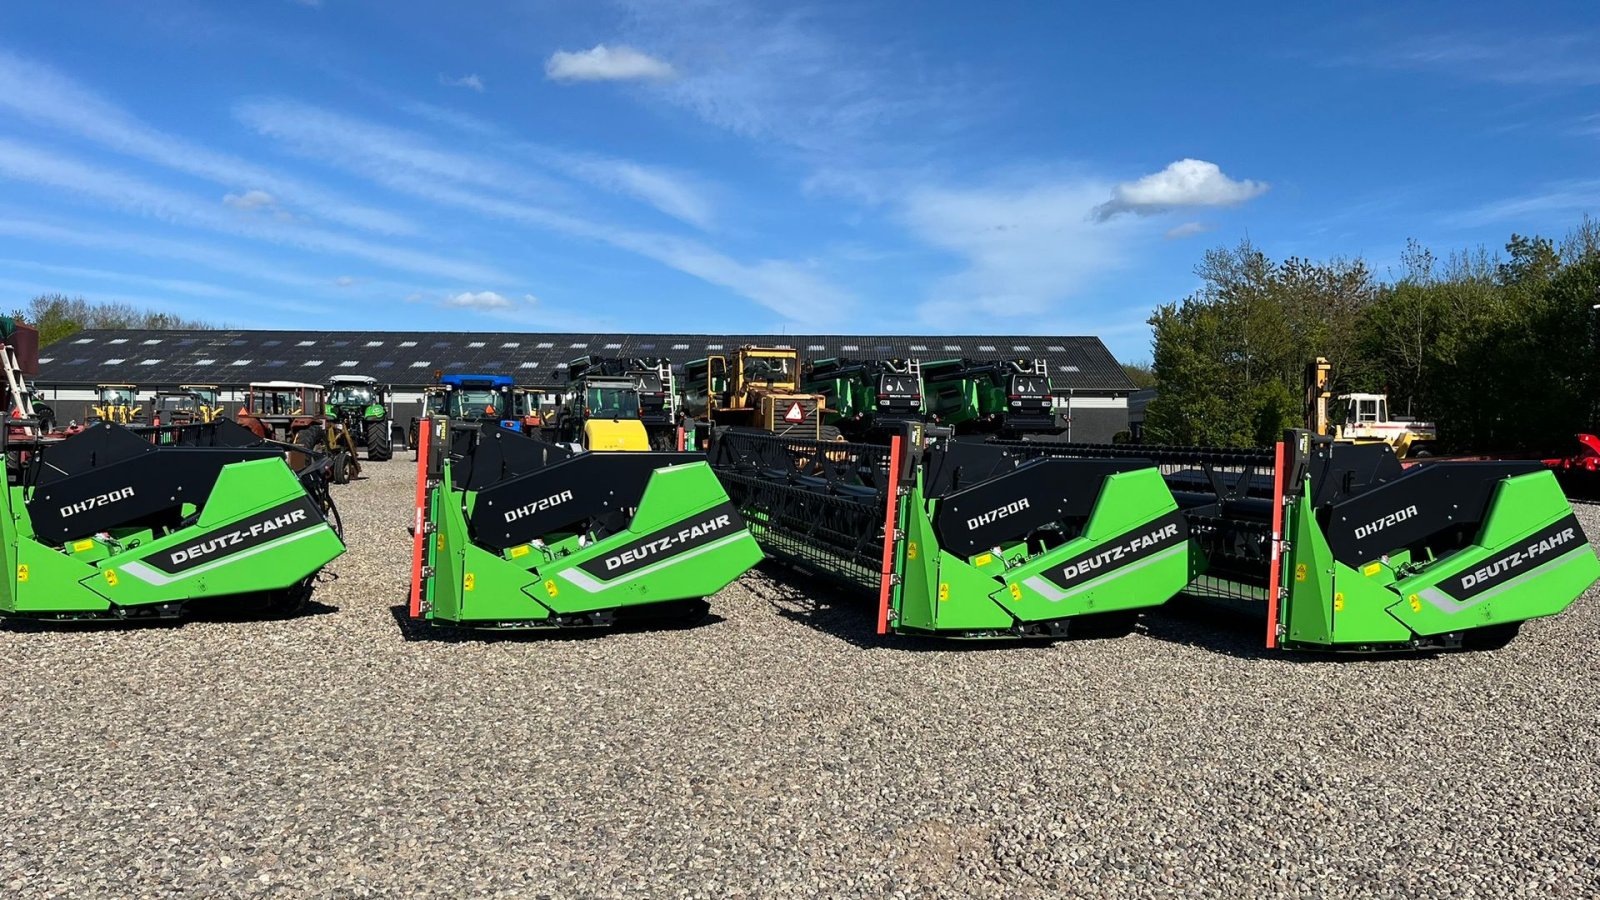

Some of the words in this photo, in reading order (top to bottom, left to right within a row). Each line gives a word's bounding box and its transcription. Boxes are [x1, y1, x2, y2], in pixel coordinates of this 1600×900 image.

[60, 486, 135, 518] DH720A
[504, 489, 574, 524] DH720A
[966, 497, 1031, 531] DH720A
[1354, 504, 1418, 540] DH720A
[170, 508, 307, 565] DEUTZ-FAHR
[604, 514, 731, 571] DEUTZ-FAHR
[1062, 522, 1179, 581] DEUTZ-FAHR
[1460, 526, 1576, 590] DEUTZ-FAHR
